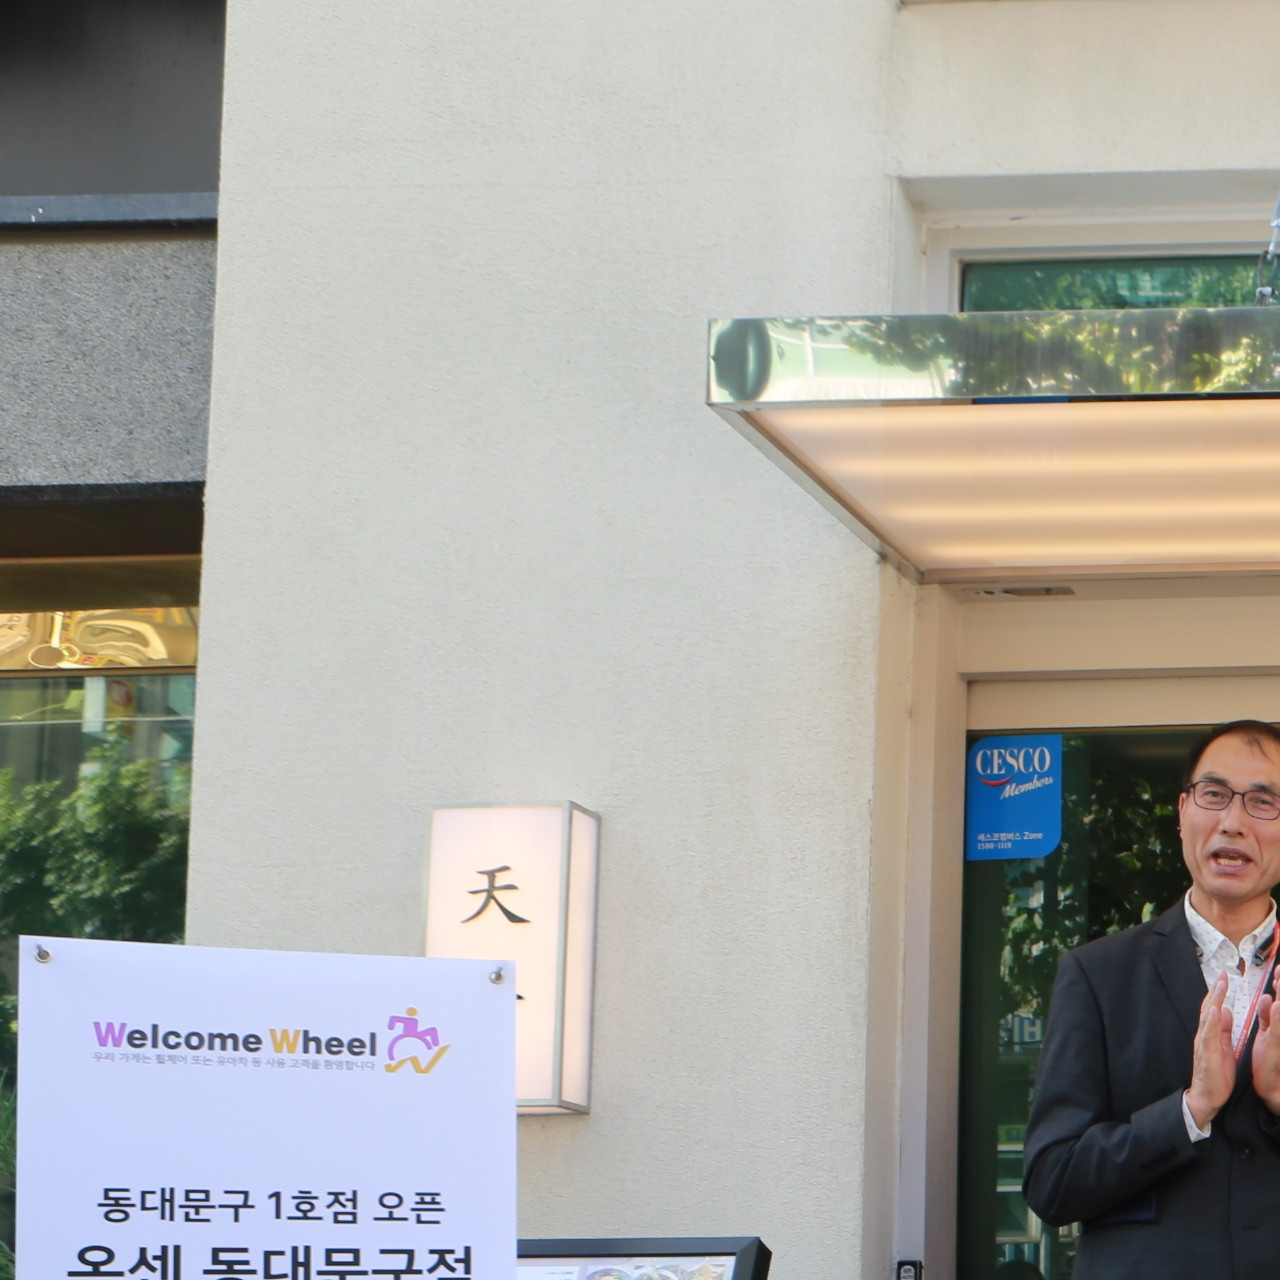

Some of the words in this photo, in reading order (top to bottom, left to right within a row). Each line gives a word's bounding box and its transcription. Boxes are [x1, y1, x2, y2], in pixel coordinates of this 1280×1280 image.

[976, 747, 1051, 775] CESCO
[1000, 774, 1054, 800] Members
[1023, 831, 1044, 840] Zone
[460, 864, 532, 924] 天
[93, 1021, 263, 1055] Welcome
[269, 1028, 378, 1058] Wheel
[92, 1051, 115, 1063] 우리
[118, 1051, 151, 1065] 가게는
[155, 1053, 188, 1066] 휠체어
[191, 1054, 212, 1066] 또는
[216, 1055, 248, 1067] 유아차
[251, 1056, 262, 1068] 등
[265, 1057, 286, 1069] 사용
[289, 1058, 321, 1070] 고객을
[324, 1059, 376, 1071] 환영합니다
[97, 1187, 256, 1224] 동대문구
[267, 1190, 359, 1225] 1호점
[373, 1191, 446, 1225] 오픈
